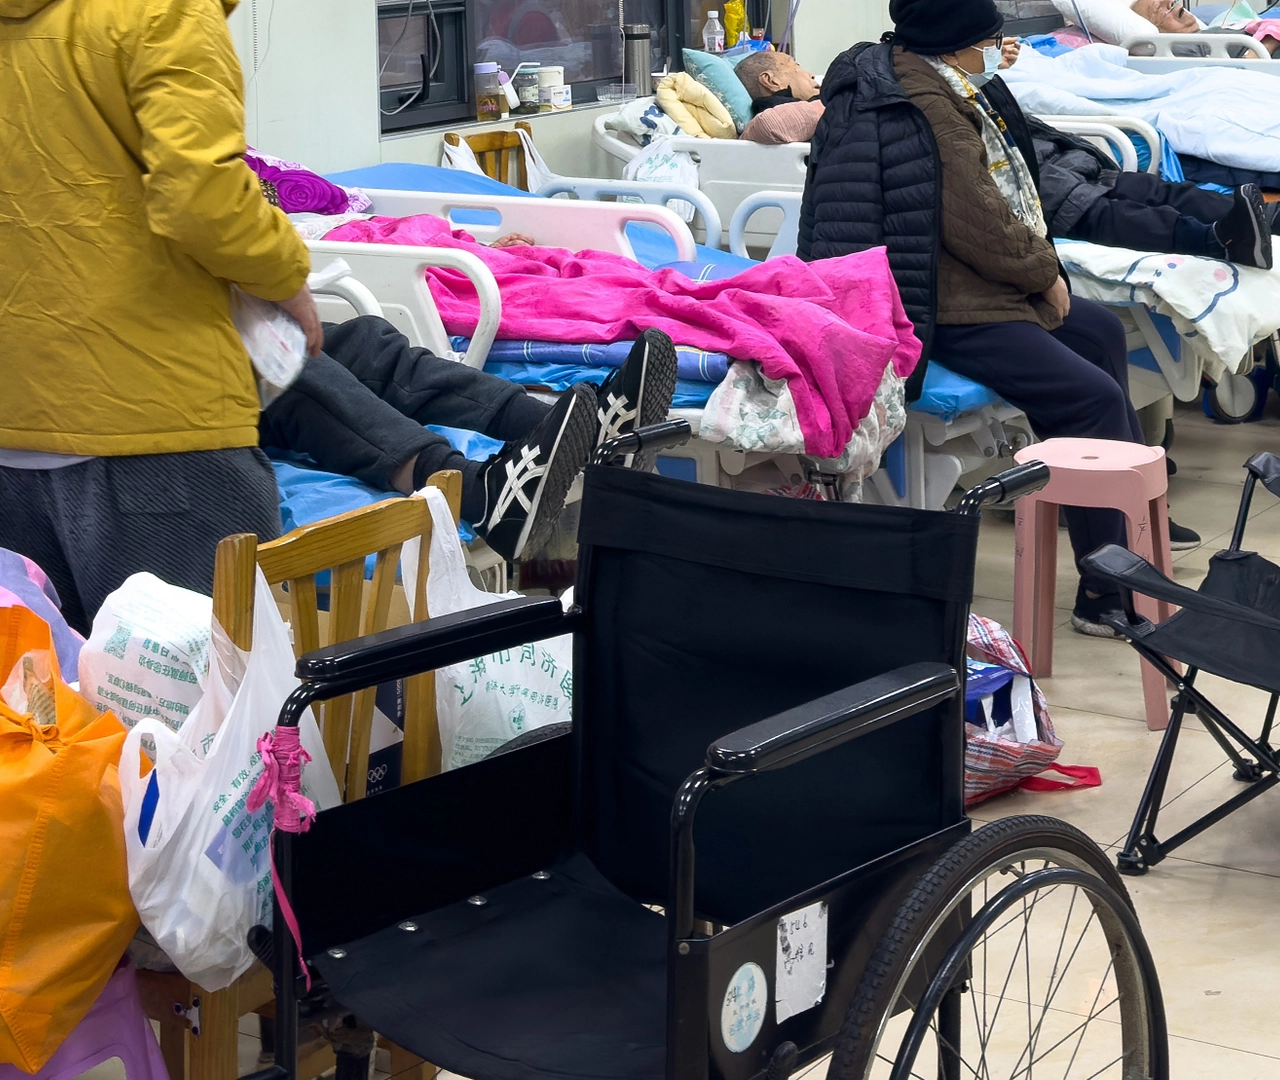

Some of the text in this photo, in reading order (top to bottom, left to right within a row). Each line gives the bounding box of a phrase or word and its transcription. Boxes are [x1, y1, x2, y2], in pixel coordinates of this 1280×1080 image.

[454, 642, 573, 720] 上海市同济医
